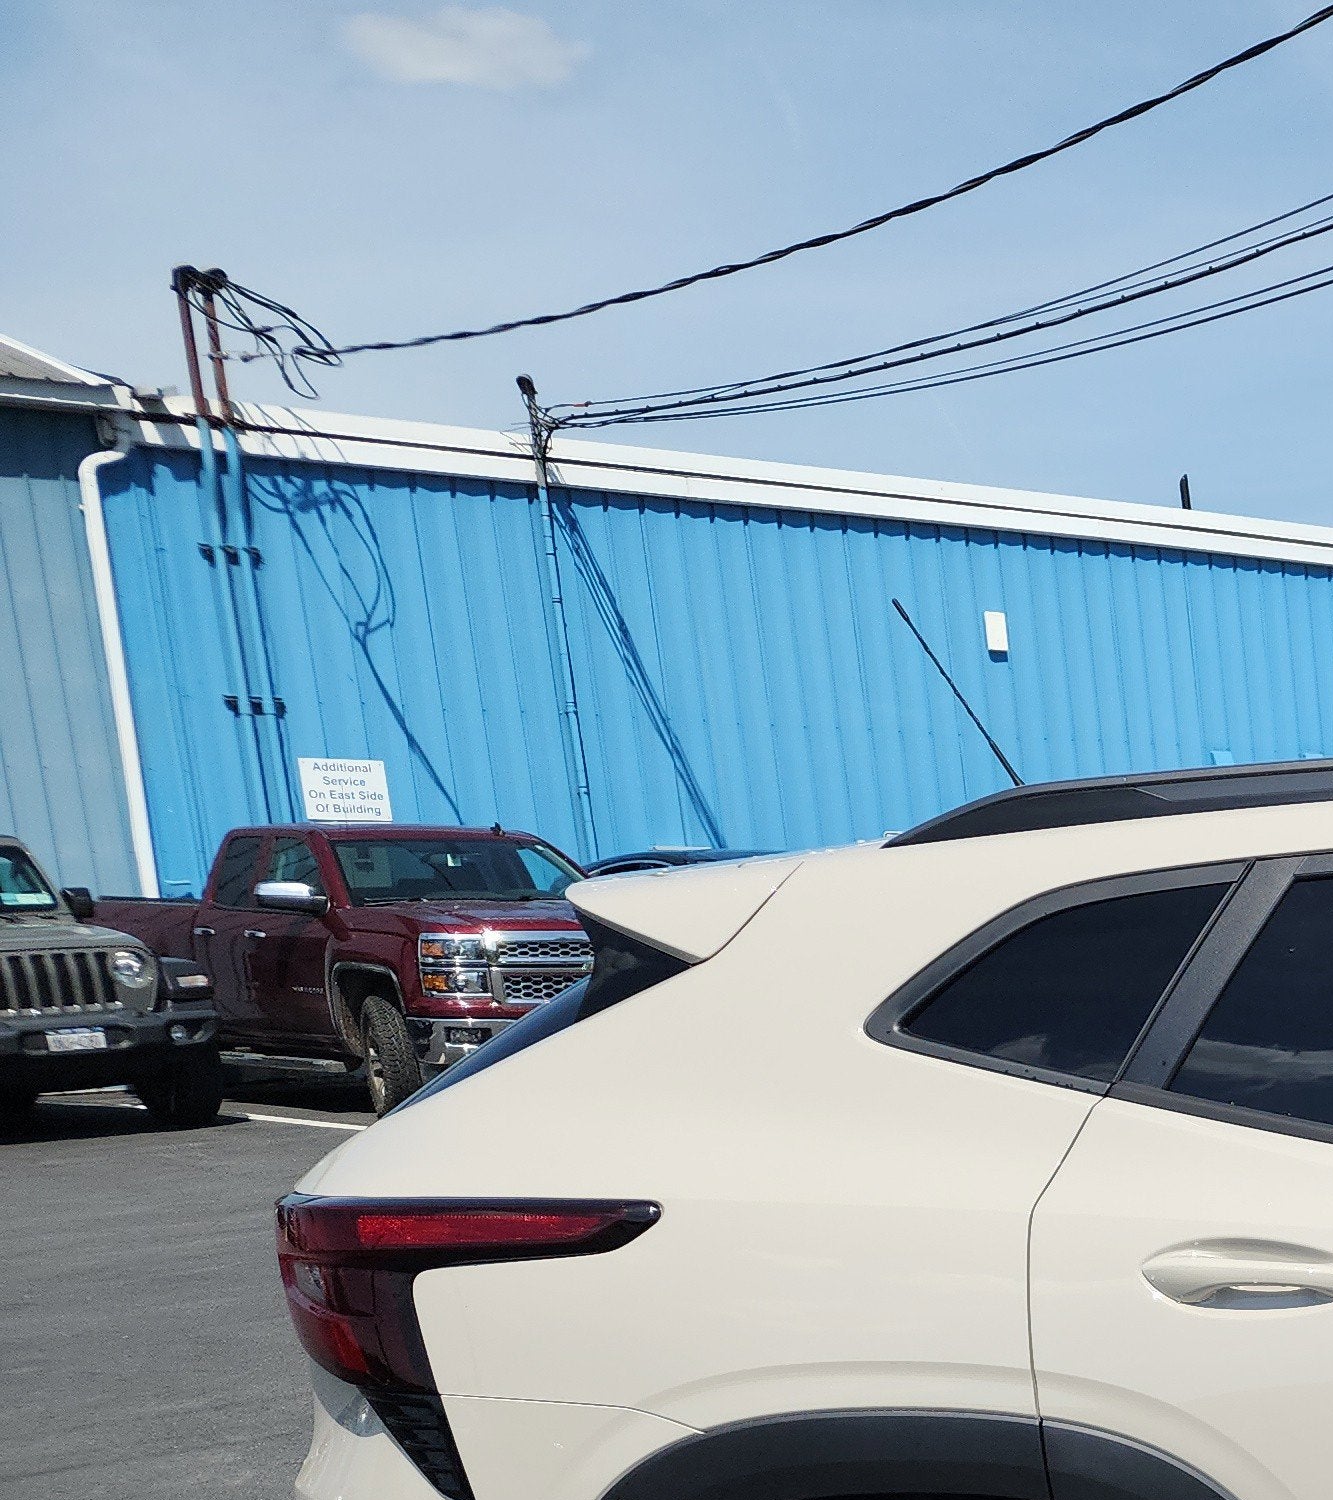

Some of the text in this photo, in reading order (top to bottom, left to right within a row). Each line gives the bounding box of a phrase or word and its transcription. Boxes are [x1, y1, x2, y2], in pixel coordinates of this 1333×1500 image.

[312, 762, 372, 773] Additional
[322, 776, 366, 787] Service
[308, 789, 384, 801] On East Side
[315, 803, 381, 816] Of Building
